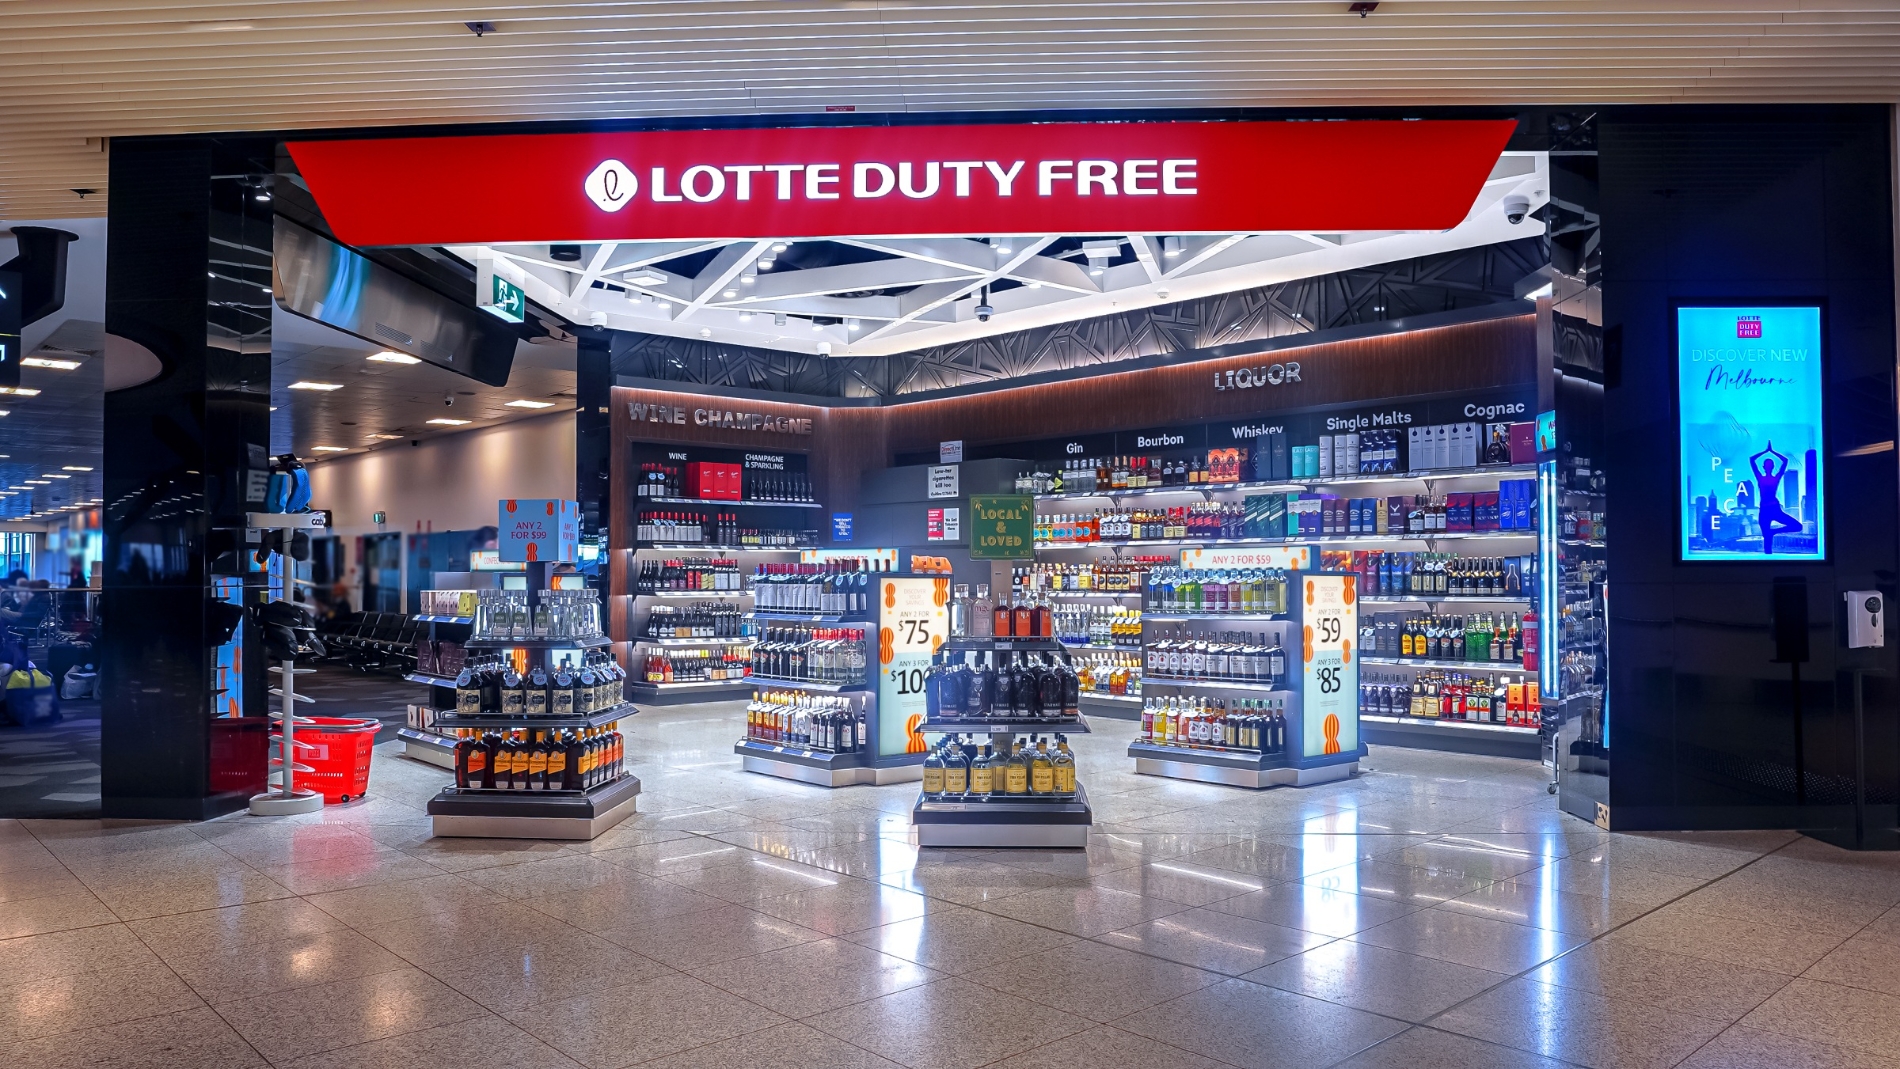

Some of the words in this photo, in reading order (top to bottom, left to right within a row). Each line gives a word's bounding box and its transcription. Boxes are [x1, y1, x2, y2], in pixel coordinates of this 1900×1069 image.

[651, 164, 840, 203] LOTTE
[853, 160, 1025, 199] DUTY
[1038, 158, 1199, 196] FREE
[1691, 348, 1767, 362] DISCOVER
[1770, 348, 1808, 362] NEW
[1214, 362, 1301, 391] LIQUOR
[1705, 364, 1798, 390] Melbourne
[1464, 402, 1525, 420] Cognac
[627, 402, 686, 425] WINE
[694, 408, 812, 435] CHAMPAGNE
[1326, 413, 1369, 432] Single
[1372, 411, 1412, 427] Malts
[1232, 424, 1284, 439] Whiskey
[1137, 434, 1184, 448] Bourbon
[668, 452, 687, 460] WINE
[1066, 443, 1084, 455] Gin
[745, 453, 784, 463] CHAMPAGNE
[750, 461, 784, 470] SPARKLING
[980, 508, 1022, 520] LOCAL
[515, 521, 535, 530] ANY
[536, 521, 542, 530] 2
[995, 521, 1007, 534] &
[510, 531, 529, 540] FOR
[531, 531, 547, 540] $99
[980, 535, 1022, 547] LOVED
[1211, 555, 1229, 564] ANY
[1230, 555, 1235, 564] 2
[1237, 554, 1254, 564] FOR
[1255, 554, 1271, 565] $59
[1328, 608, 1331, 616] 2
[898, 619, 930, 645] $75
[1316, 617, 1341, 643] $59
[1327, 658, 1331, 666] 3
[890, 668, 927, 695] $10
[1316, 667, 1341, 694] $85
